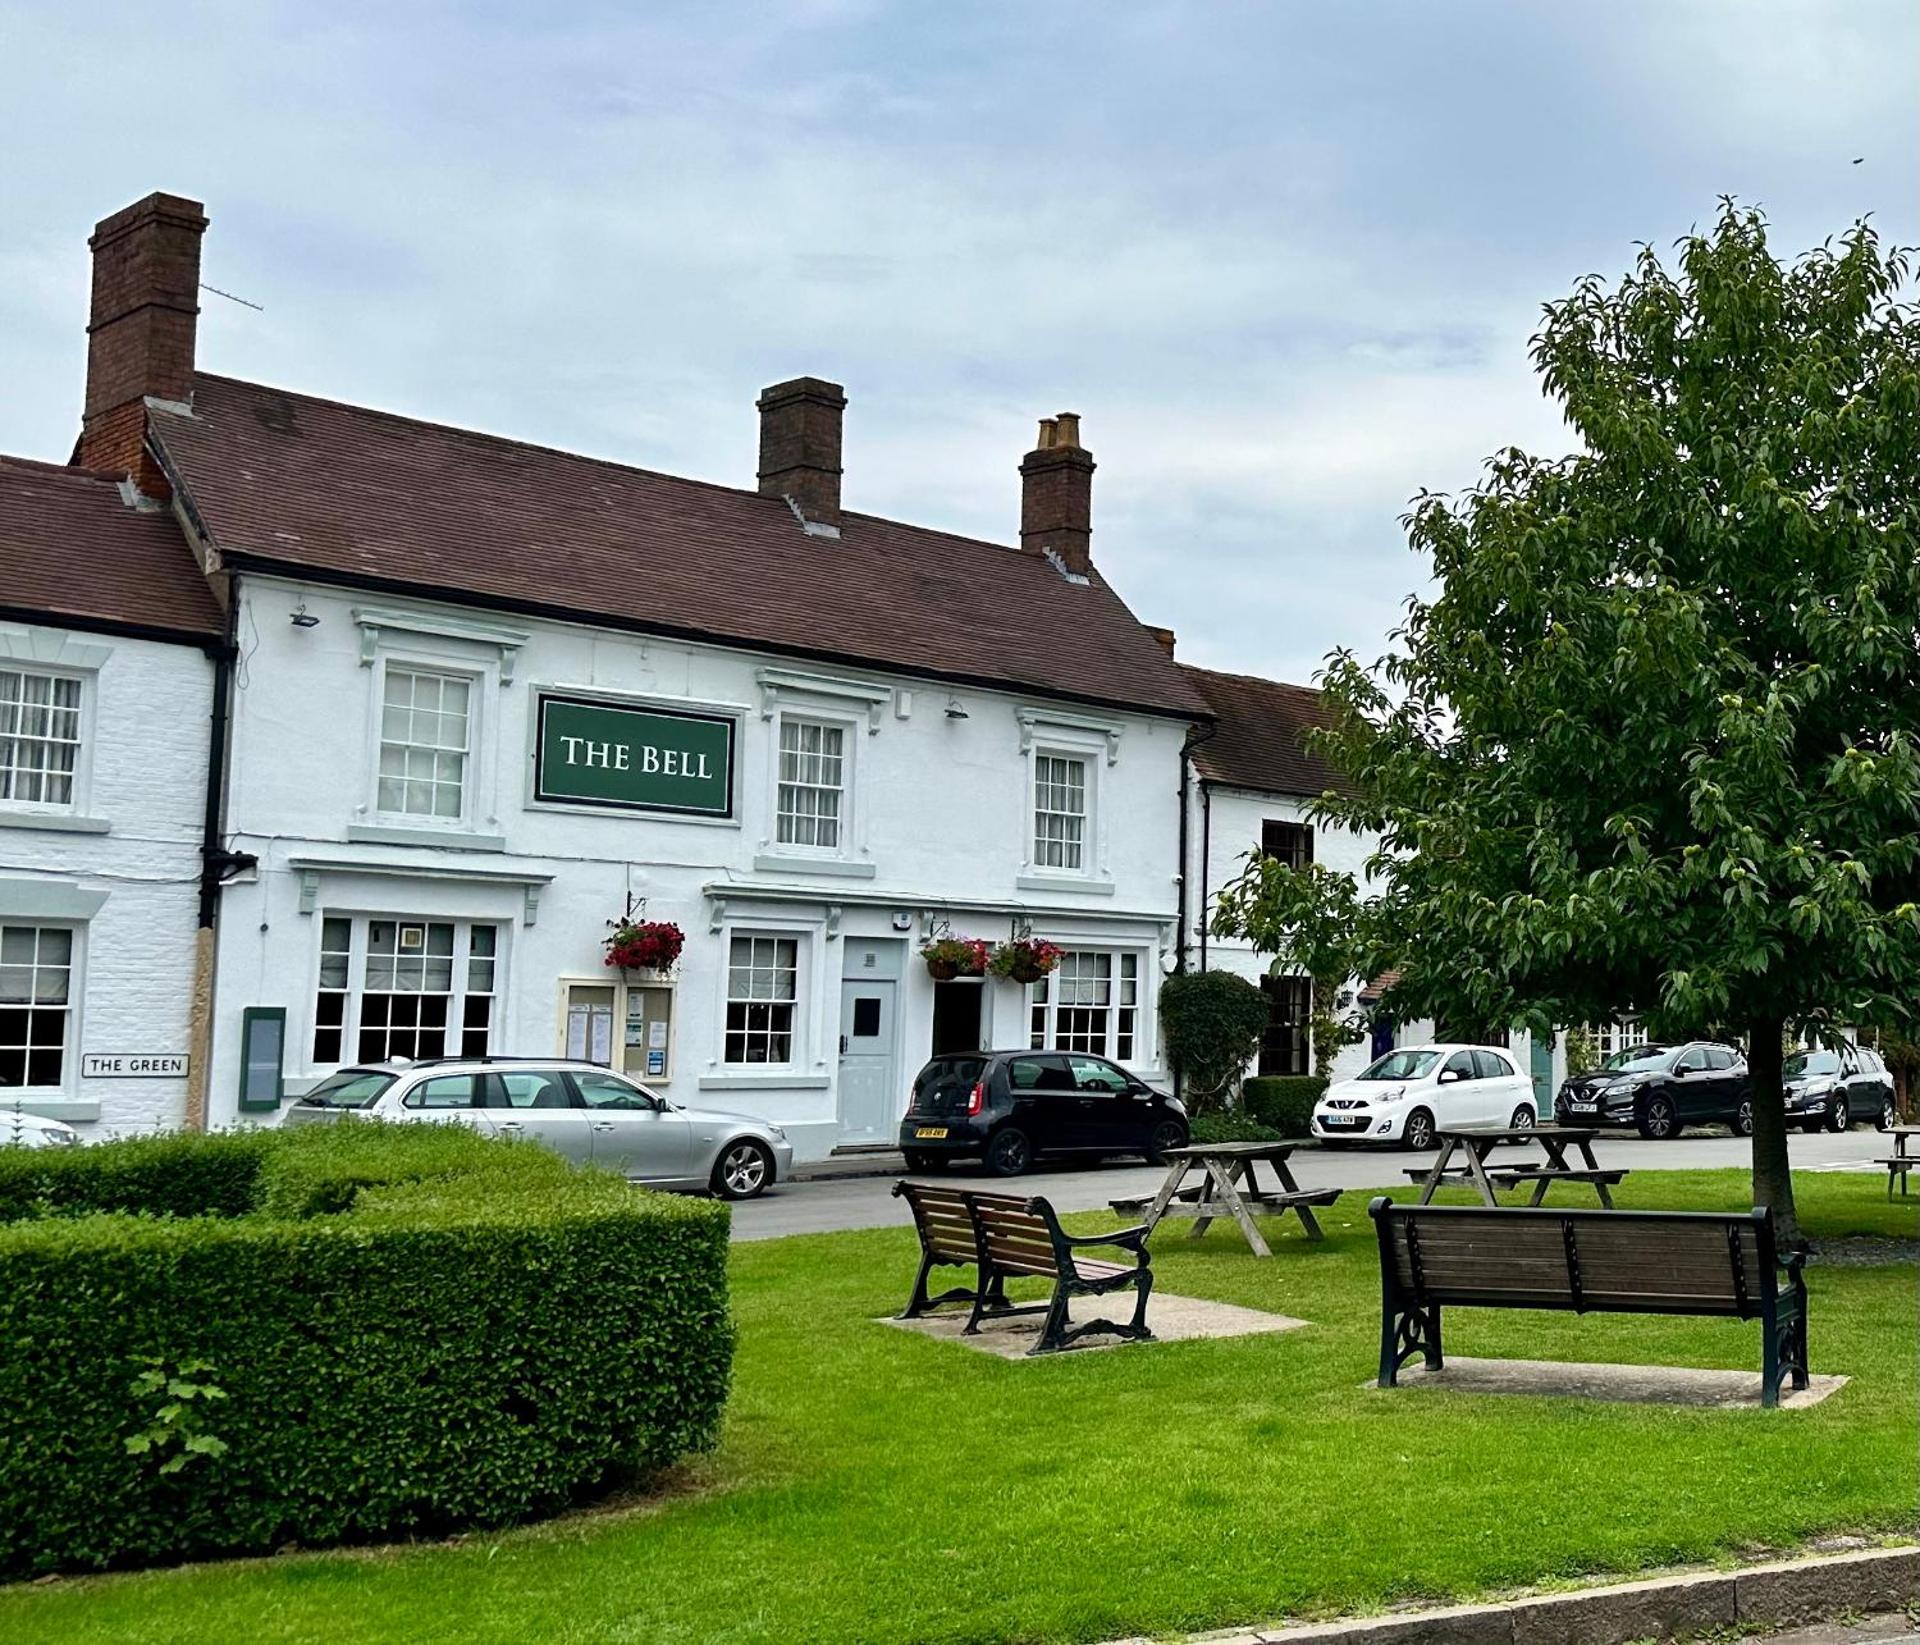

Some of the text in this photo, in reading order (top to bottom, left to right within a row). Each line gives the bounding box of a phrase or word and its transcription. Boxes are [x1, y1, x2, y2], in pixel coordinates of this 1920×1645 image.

[560, 736, 713, 779] THE BELL
[91, 1059, 182, 1071] THE GREEN
